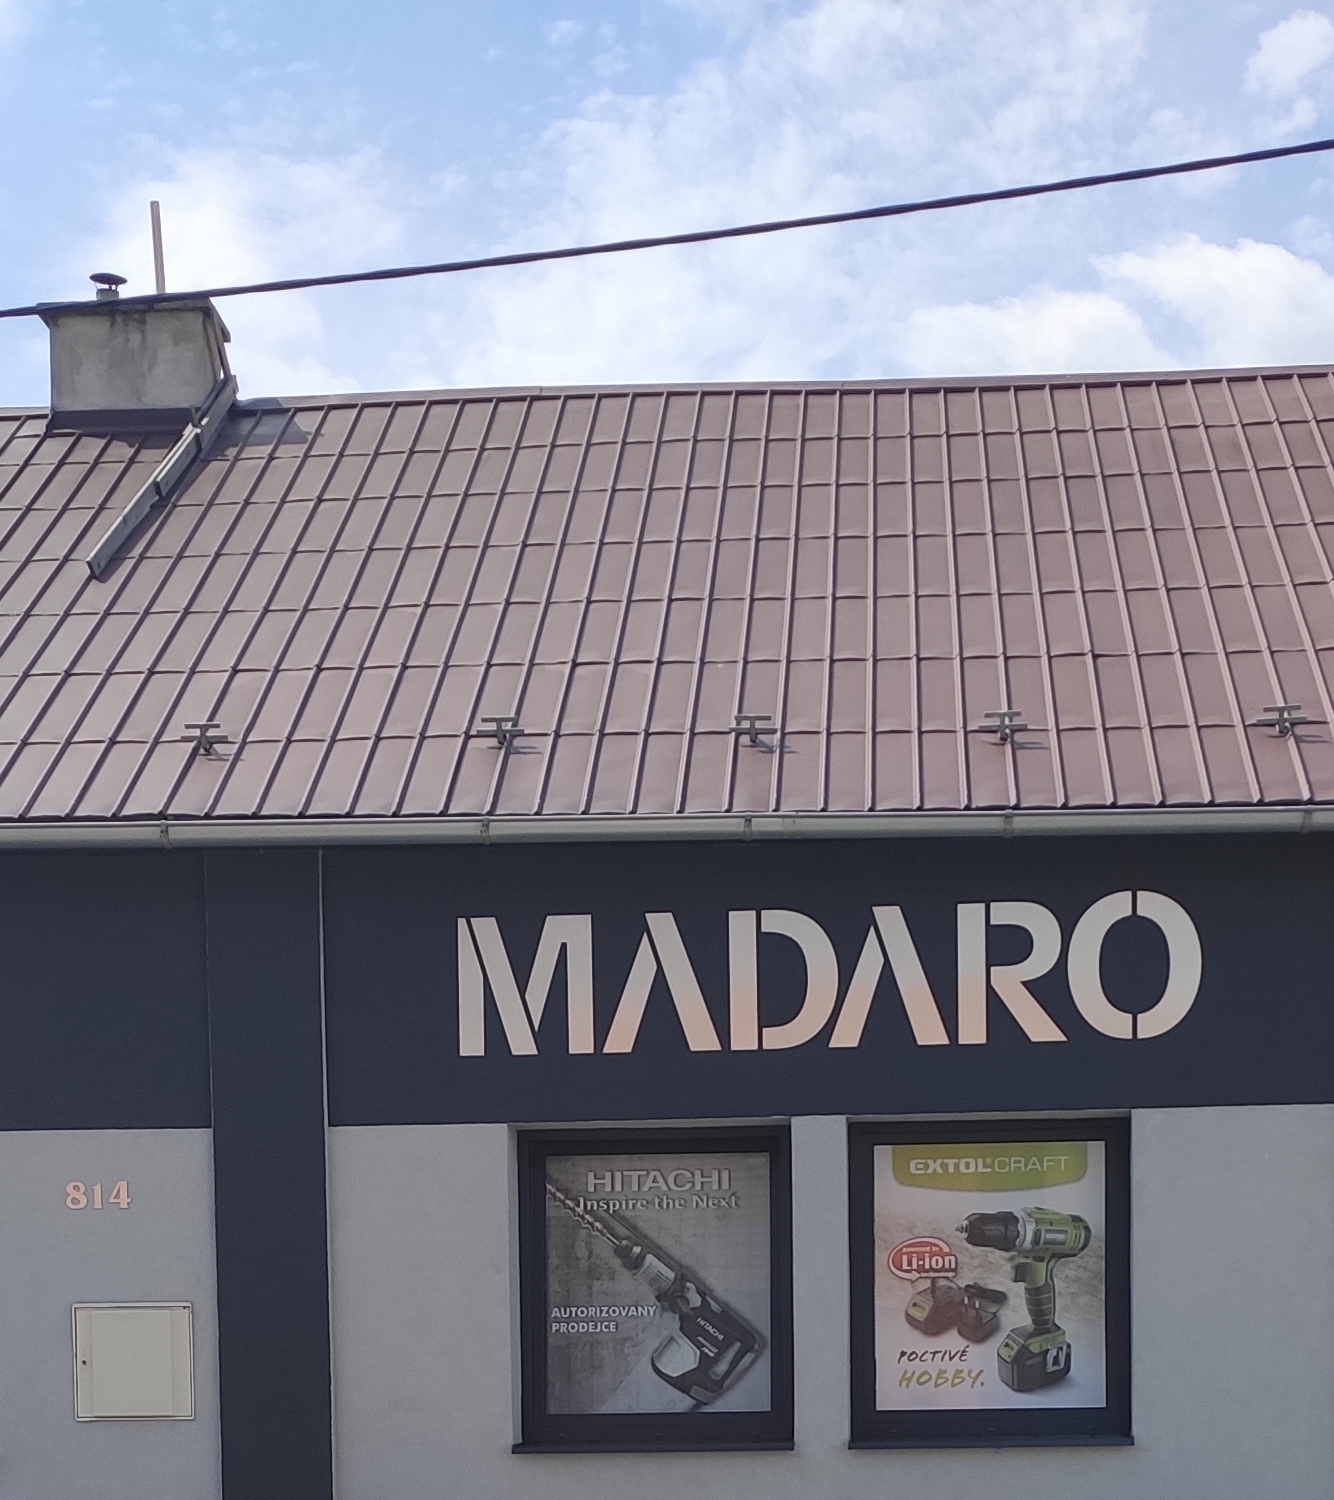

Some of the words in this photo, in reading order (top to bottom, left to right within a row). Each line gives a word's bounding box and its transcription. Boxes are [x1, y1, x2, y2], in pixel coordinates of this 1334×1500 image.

[457, 890, 1203, 1057] MADARO
[994, 1156, 1069, 1173] CRAFT
[587, 1168, 732, 1193] HITACHI
[65, 1181, 132, 1210] 814
[576, 1196, 651, 1213] Inspire
[654, 1194, 687, 1209] the
[692, 1191, 740, 1210] Next
[902, 1253, 957, 1270] Li-ion
[551, 1303, 658, 1318] AUTORIZOVANÝ
[552, 1321, 618, 1334] PRODEJCE
[897, 1345, 971, 1364] POCTIVÉ
